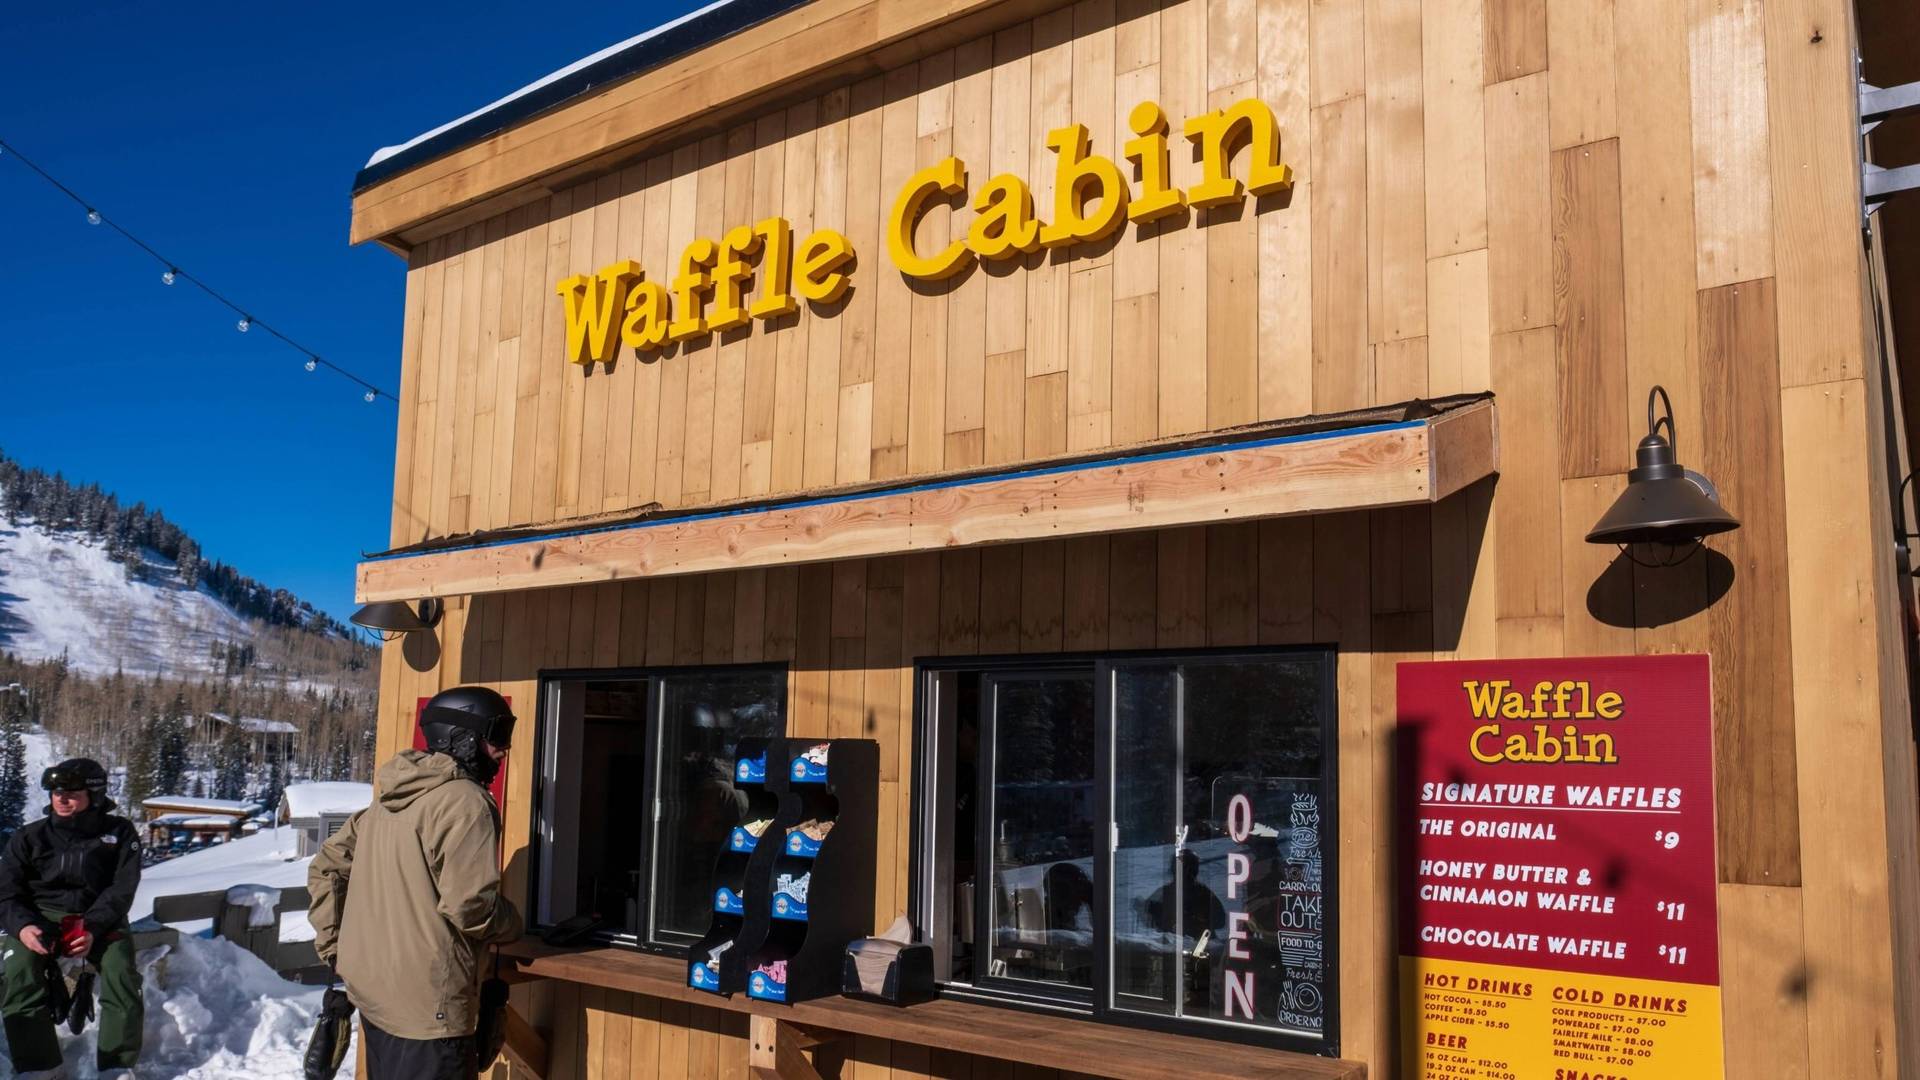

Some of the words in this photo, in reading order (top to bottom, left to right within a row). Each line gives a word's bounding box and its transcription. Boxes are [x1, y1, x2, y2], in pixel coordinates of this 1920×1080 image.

[558, 217, 857, 365] Waffle
[889, 98, 1293, 280] Cabin
[1463, 680, 1624, 719] Waffle
[1470, 724, 1618, 764] Cabin
[1421, 782, 1555, 804] SIGNATURE
[1566, 786, 1681, 808] WAFFLES
[1420, 819, 1454, 835] THE
[1460, 820, 1556, 840] ORIGINAL
[1655, 830, 1679, 849] $9
[1420, 860, 1486, 879] HONEY
[1493, 864, 1568, 884] BUTTER
[1577, 869, 1591, 885] &
[1224, 794, 1254, 1019] OPEN
[1281, 894, 1322, 913] TAKE
[1420, 885, 1528, 907] CINNAMON
[1537, 892, 1615, 914] WAFFLE
[1657, 901, 1685, 920] $11
[1281, 911, 1316, 929] OUT
[1281, 937, 1302, 948] FOOD
[1421, 926, 1539, 951] CHOCOLATE
[1547, 936, 1626, 959] WAFFLE
[1659, 945, 1686, 964] $11
[1286, 968, 1313, 980] Fresh
[1425, 973, 1459, 988] HOT
[1467, 977, 1532, 996] DRINKS
[1444, 995, 1471, 1004] COCOA
[1483, 1000, 1506, 1008] $5.50
[1553, 987, 1604, 1004] COLD
[1614, 993, 1687, 1013] DRINKS
[1425, 1003, 1452, 1012] COFFEE
[1464, 1008, 1487, 1016] $5.50
[1552, 1008, 1574, 1017] COKE
[1578, 1011, 1625, 1022] PRODUCTS
[1637, 1017, 1666, 1027] $7.00
[1425, 1014, 1448, 1022] APPLE
[1452, 1016, 1474, 1025] CIDER
[1486, 1021, 1509, 1029] $5.50
[1553, 1018, 1600, 1030] POWERADE
[1612, 1025, 1640, 1034] $7.00
[1427, 1032, 1467, 1049] BEER
[1553, 1029, 1588, 1039] FAIRLIFE
[1592, 1033, 1613, 1042] MILK
[1625, 1037, 1653, 1047] $8.00
[1553, 1039, 1610, 1052] SMARTWATER
[1623, 1048, 1651, 1057] $8.00
[1554, 1049, 1570, 1058] RED
[1574, 1052, 1594, 1061] BULL
[1606, 1056, 1634, 1065] $7.00
[1426, 1062, 1442, 1070] 19.2
[1460, 1067, 1475, 1075] CAN
[1487, 1071, 1515, 1080] $14.00
[1452, 1056, 1467, 1064] CAN
[1479, 1060, 1507, 1069] $12.00
[1555, 1069, 1628, 1080] SNA
